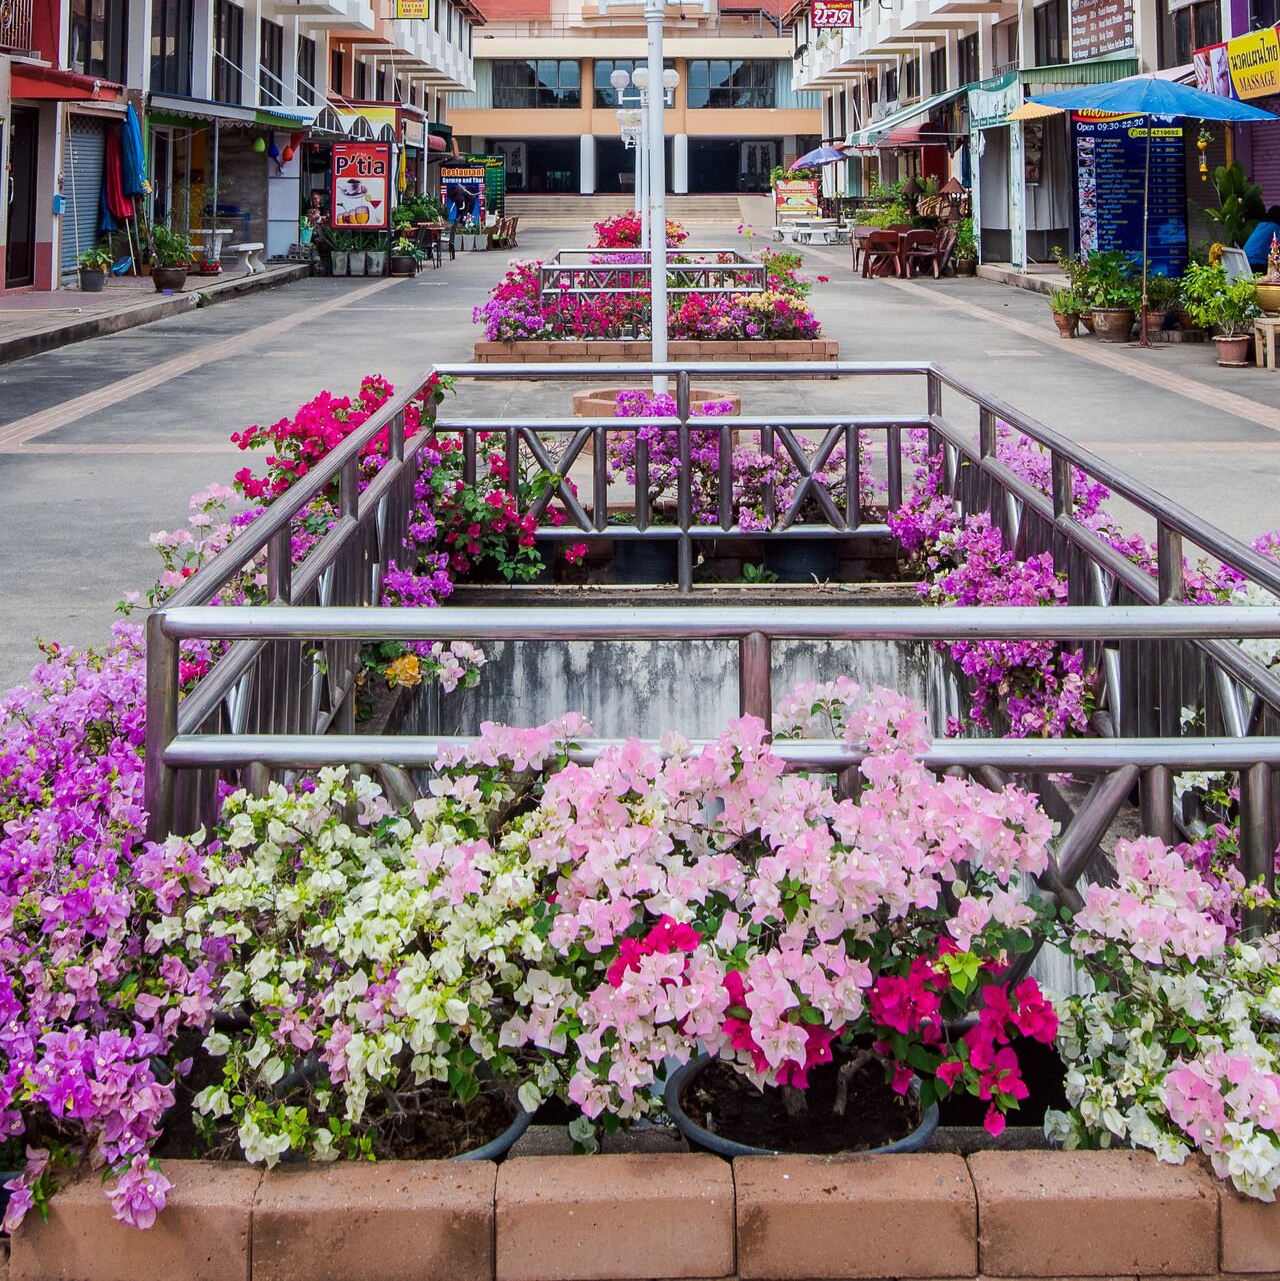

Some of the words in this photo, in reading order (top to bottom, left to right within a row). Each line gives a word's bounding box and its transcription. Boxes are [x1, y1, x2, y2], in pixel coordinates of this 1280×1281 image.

[814, 9, 853, 24] นวด
[1230, 37, 1279, 71] นวดแผนไทย
[1238, 70, 1277, 93] MASSAGE
[1076, 122, 1095, 133] Open
[1097, 118, 1144, 131] 09:30-22:30
[334, 155, 386, 176] P'tia
[440, 166, 486, 177] Restaurant
